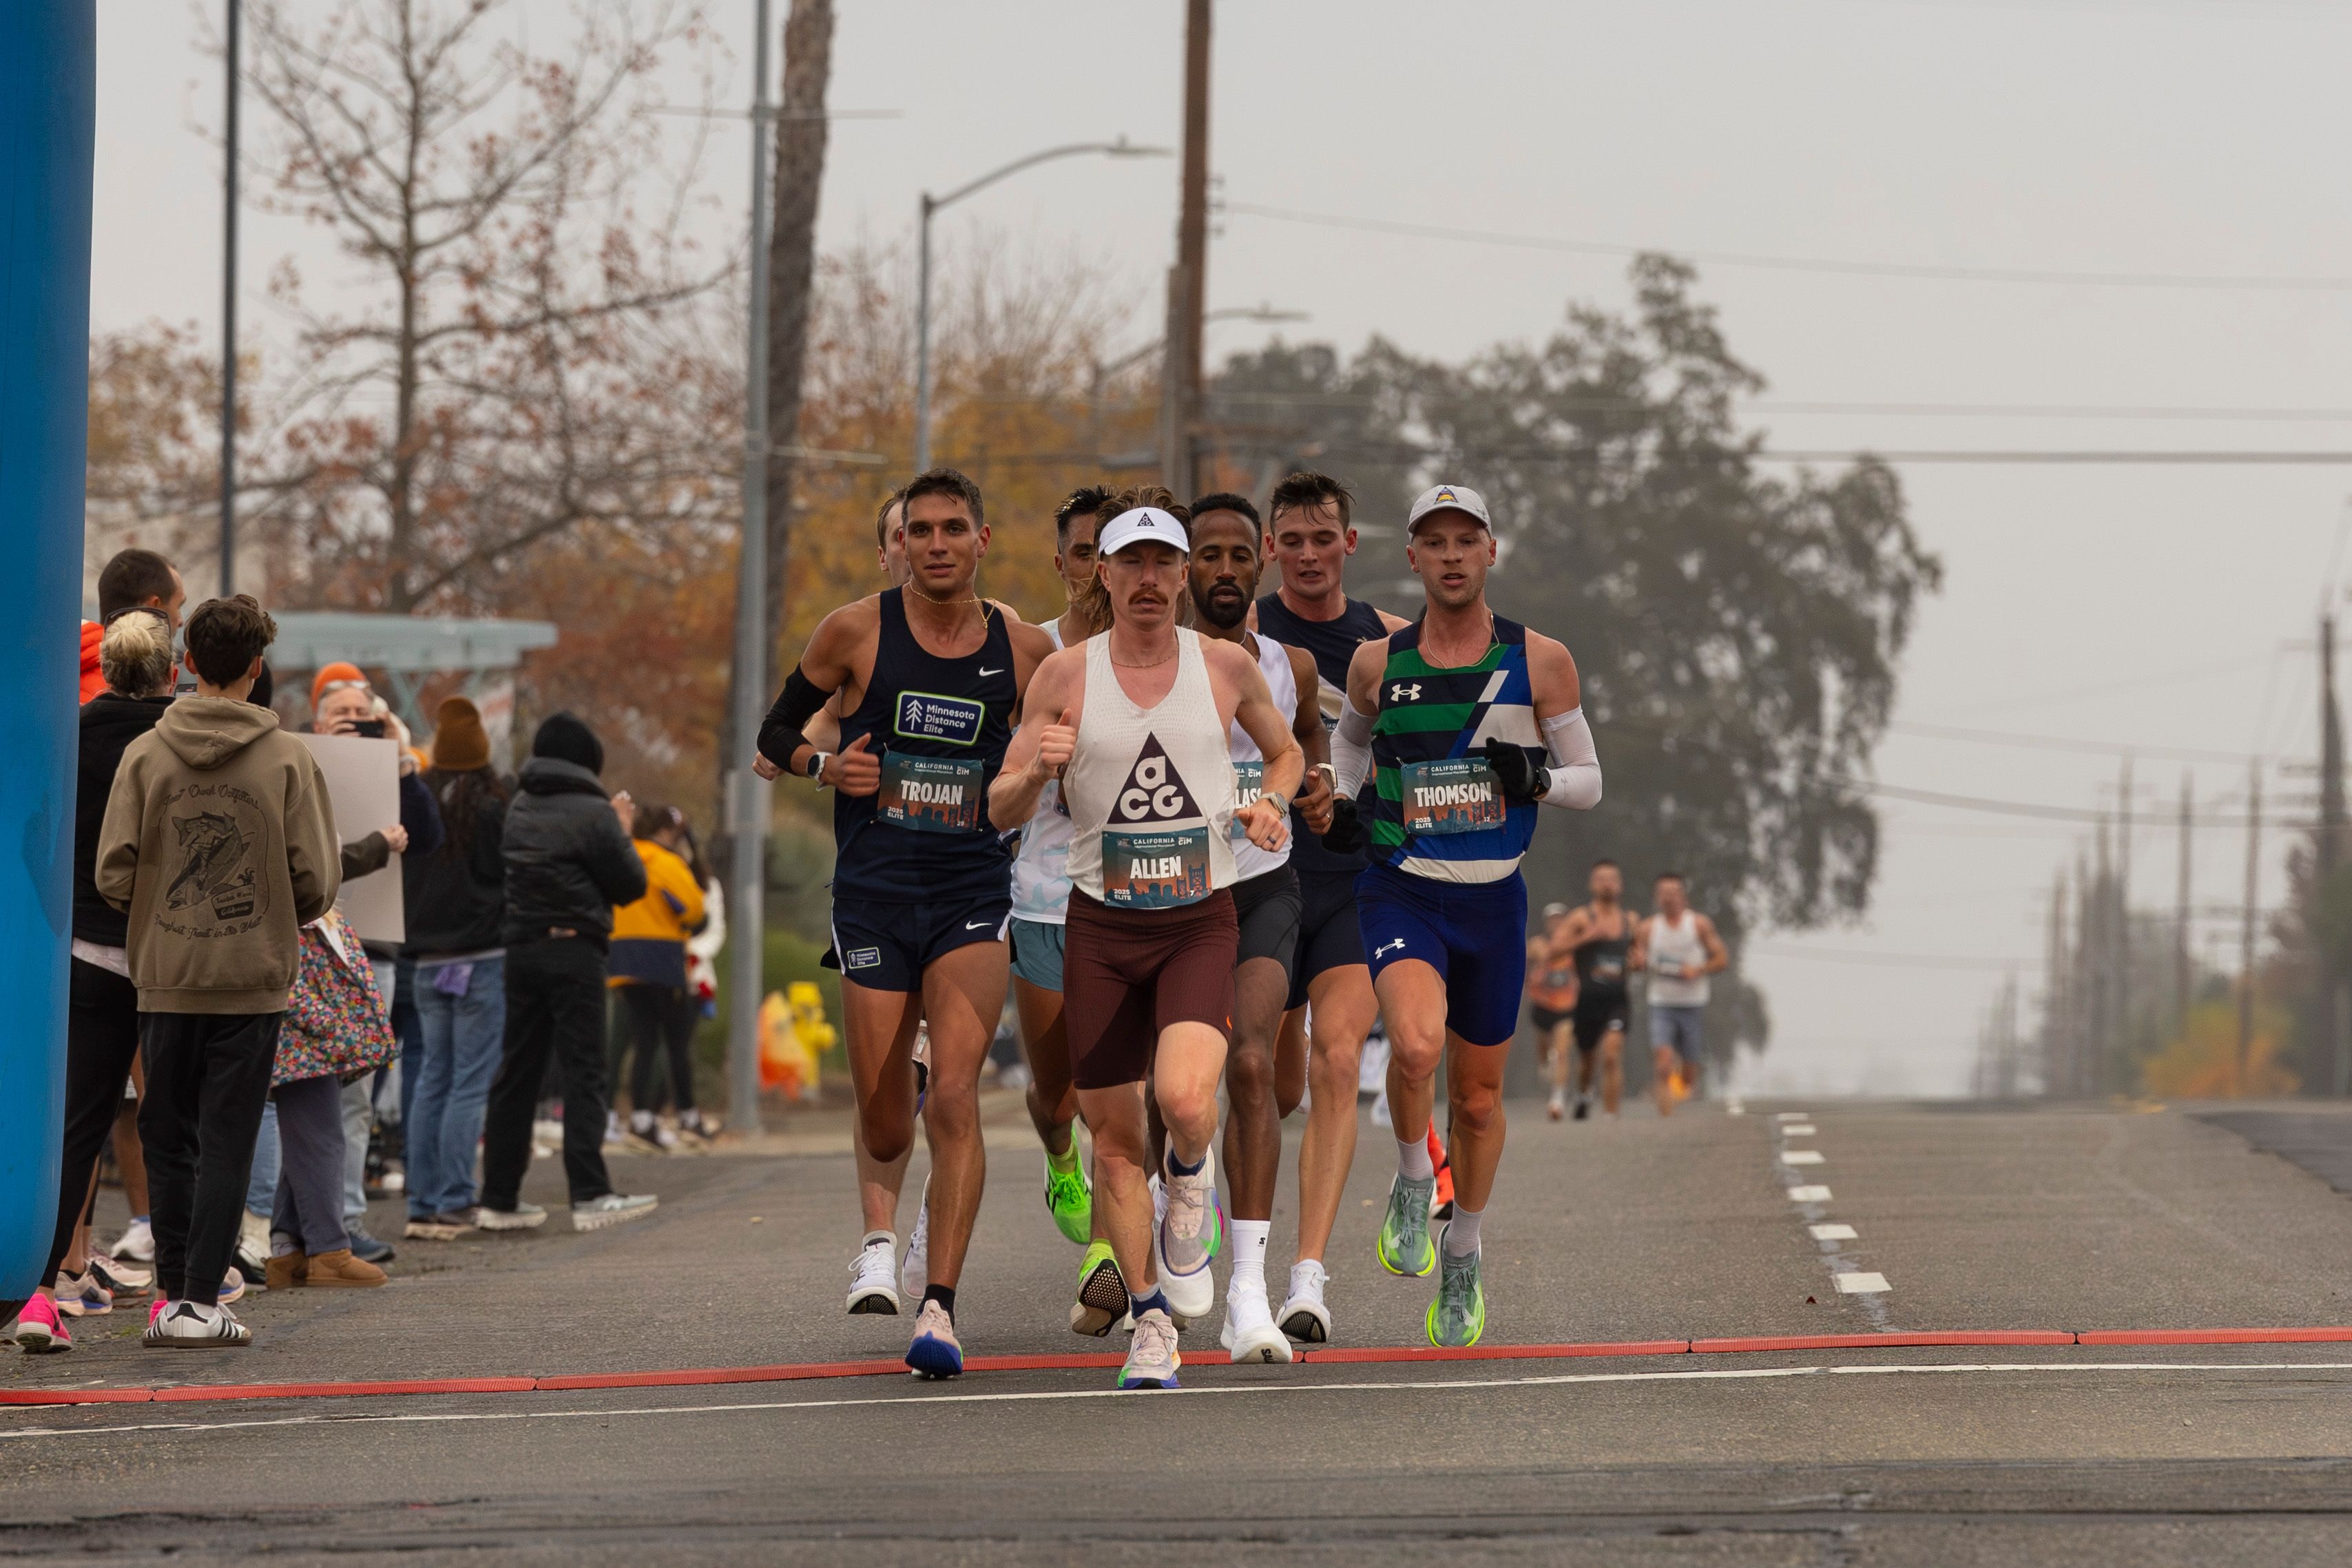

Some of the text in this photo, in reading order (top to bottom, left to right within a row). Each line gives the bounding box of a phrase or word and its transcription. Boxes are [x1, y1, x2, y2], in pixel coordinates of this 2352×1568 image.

[926, 704, 975, 720] Minnesota
[925, 714, 966, 729] Distance
[924, 724, 944, 734] Elite
[915, 762, 954, 771] CALIFORNIA
[1431, 764, 1469, 772] CALIFORNIA
[901, 780, 964, 805] TROJAN
[1414, 782, 1492, 808] THOMSON
[887, 812, 904, 820] ELITE
[1178, 837, 1192, 846] CIM
[1130, 855, 1182, 879] ALLEN
